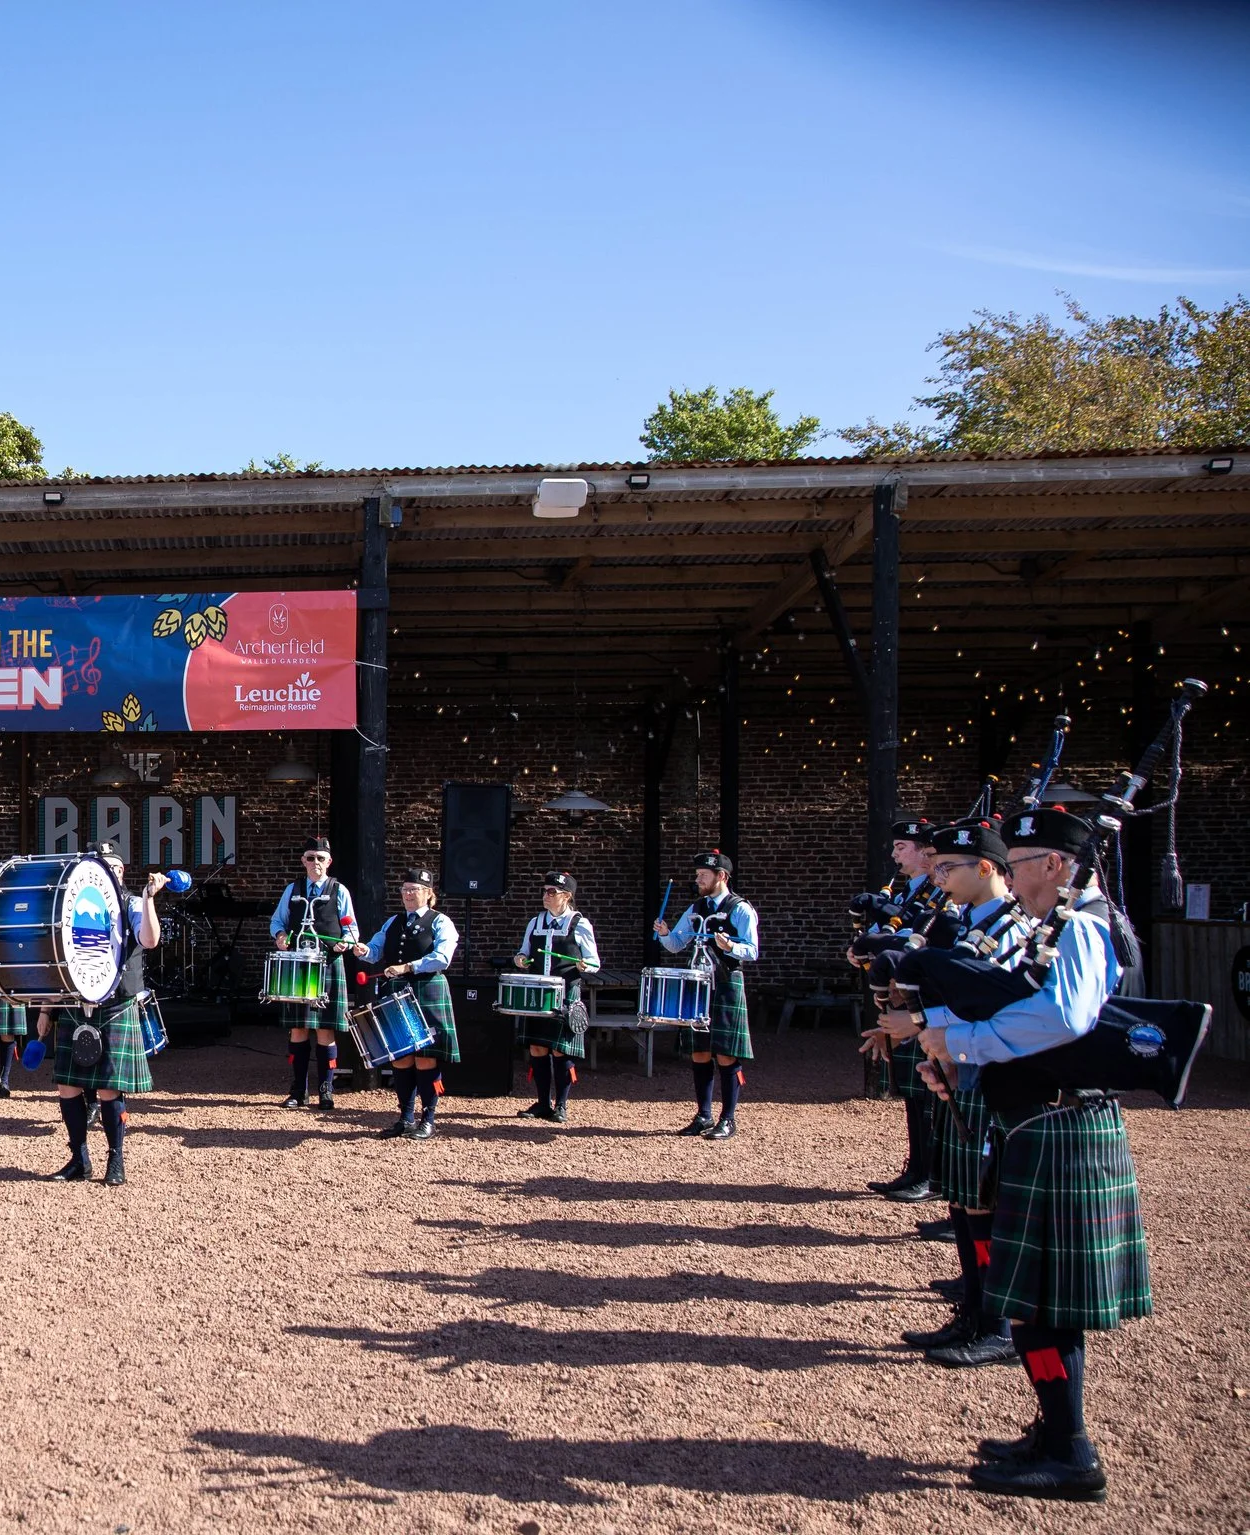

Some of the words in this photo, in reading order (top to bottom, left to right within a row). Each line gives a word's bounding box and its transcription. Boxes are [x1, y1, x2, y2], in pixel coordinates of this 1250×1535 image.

[9, 629, 53, 658] THE
[234, 639, 323, 654] Archerfield
[235, 684, 321, 702] Leuchie
[239, 703, 286, 713] Reimagining
[288, 703, 316, 711] Respite
[122, 753, 161, 782] HE
[38, 795, 237, 868] BARN
[65, 874, 86, 927] NORTH
[88, 870, 118, 932] BERWICK
[70, 955, 87, 985] PIPE
[90, 960, 112, 988] BAND
